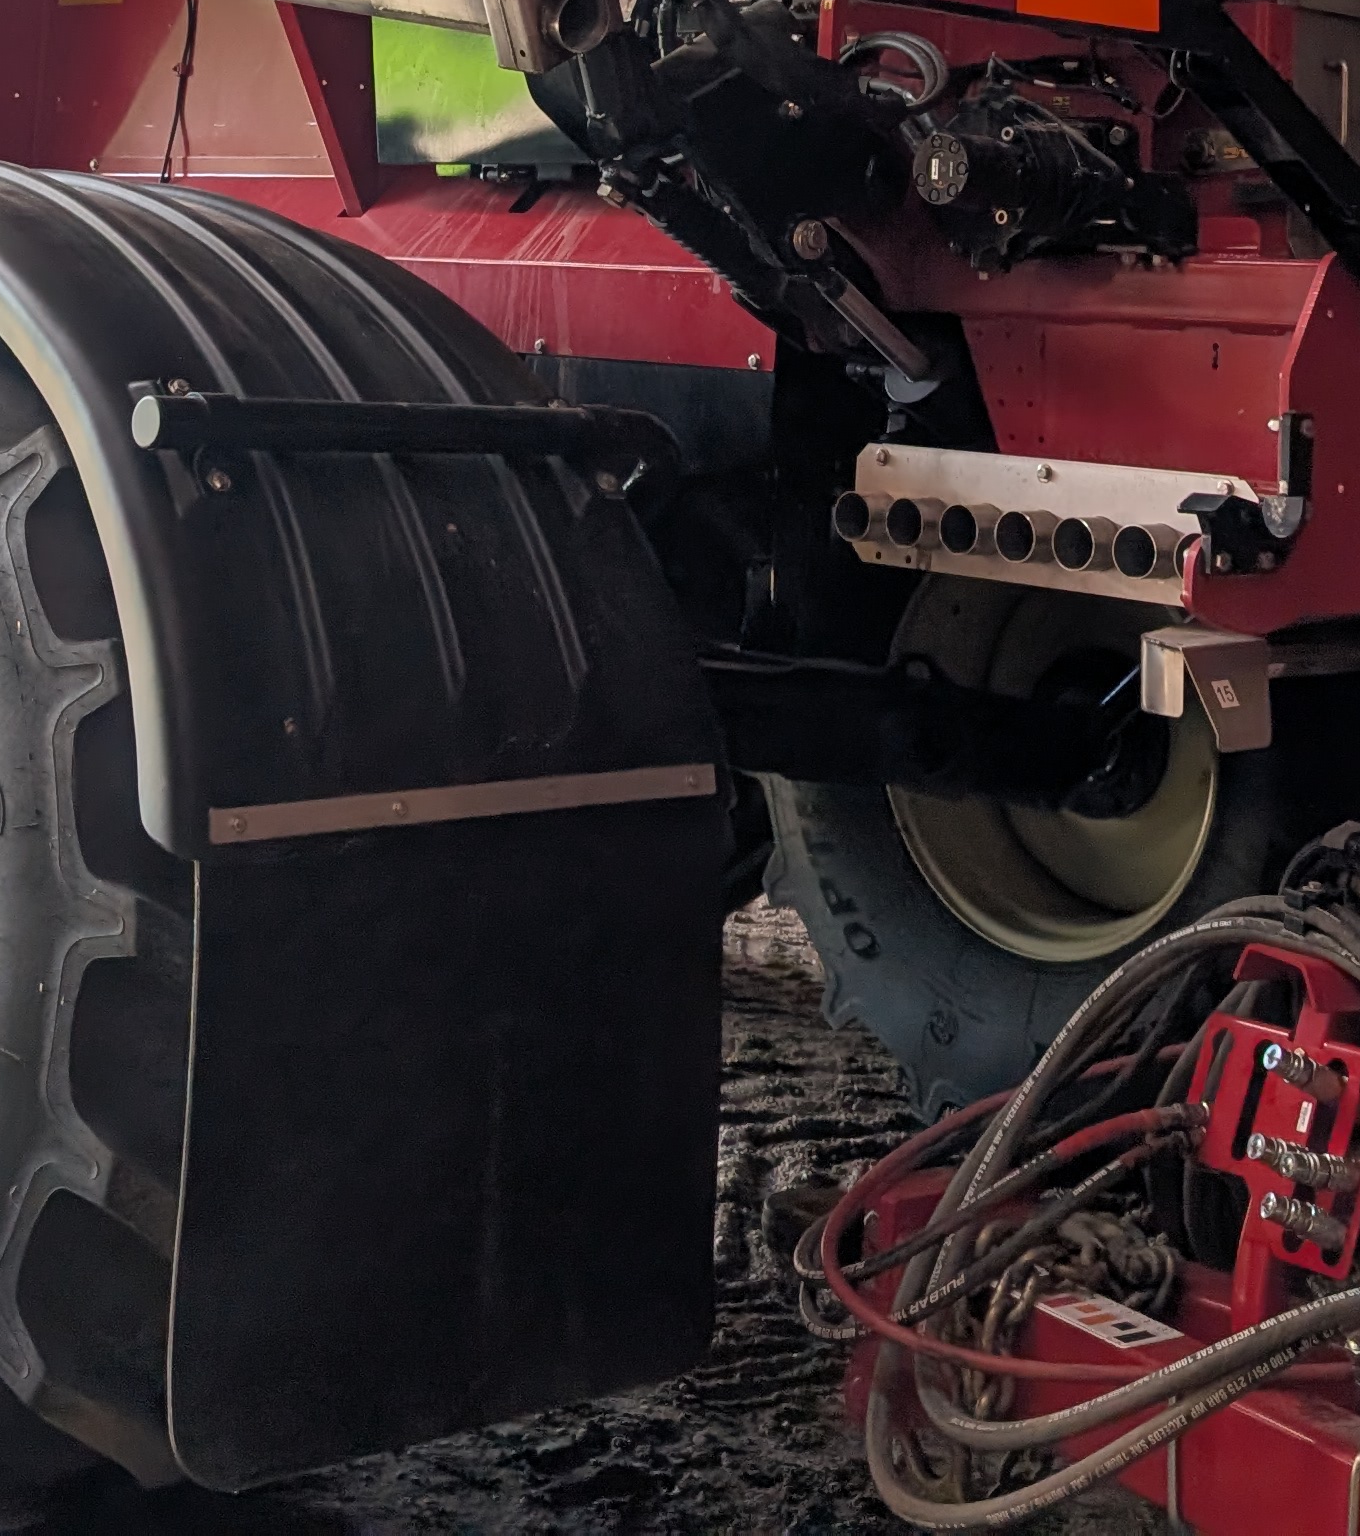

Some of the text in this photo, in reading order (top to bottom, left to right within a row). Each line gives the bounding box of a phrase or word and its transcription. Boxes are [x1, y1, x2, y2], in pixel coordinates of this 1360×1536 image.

[1216, 684, 1236, 704] 15
[1215, 1326, 1256, 1349] EXCEEDS
[1251, 1362, 1270, 1379] PSI
[1226, 1376, 1247, 1395] 215
[1205, 1388, 1227, 1407] BAR
[1190, 1401, 1209, 1419] WP
[1147, 1413, 1188, 1445] EXCEEDS
[1129, 1439, 1150, 1456] SAE
